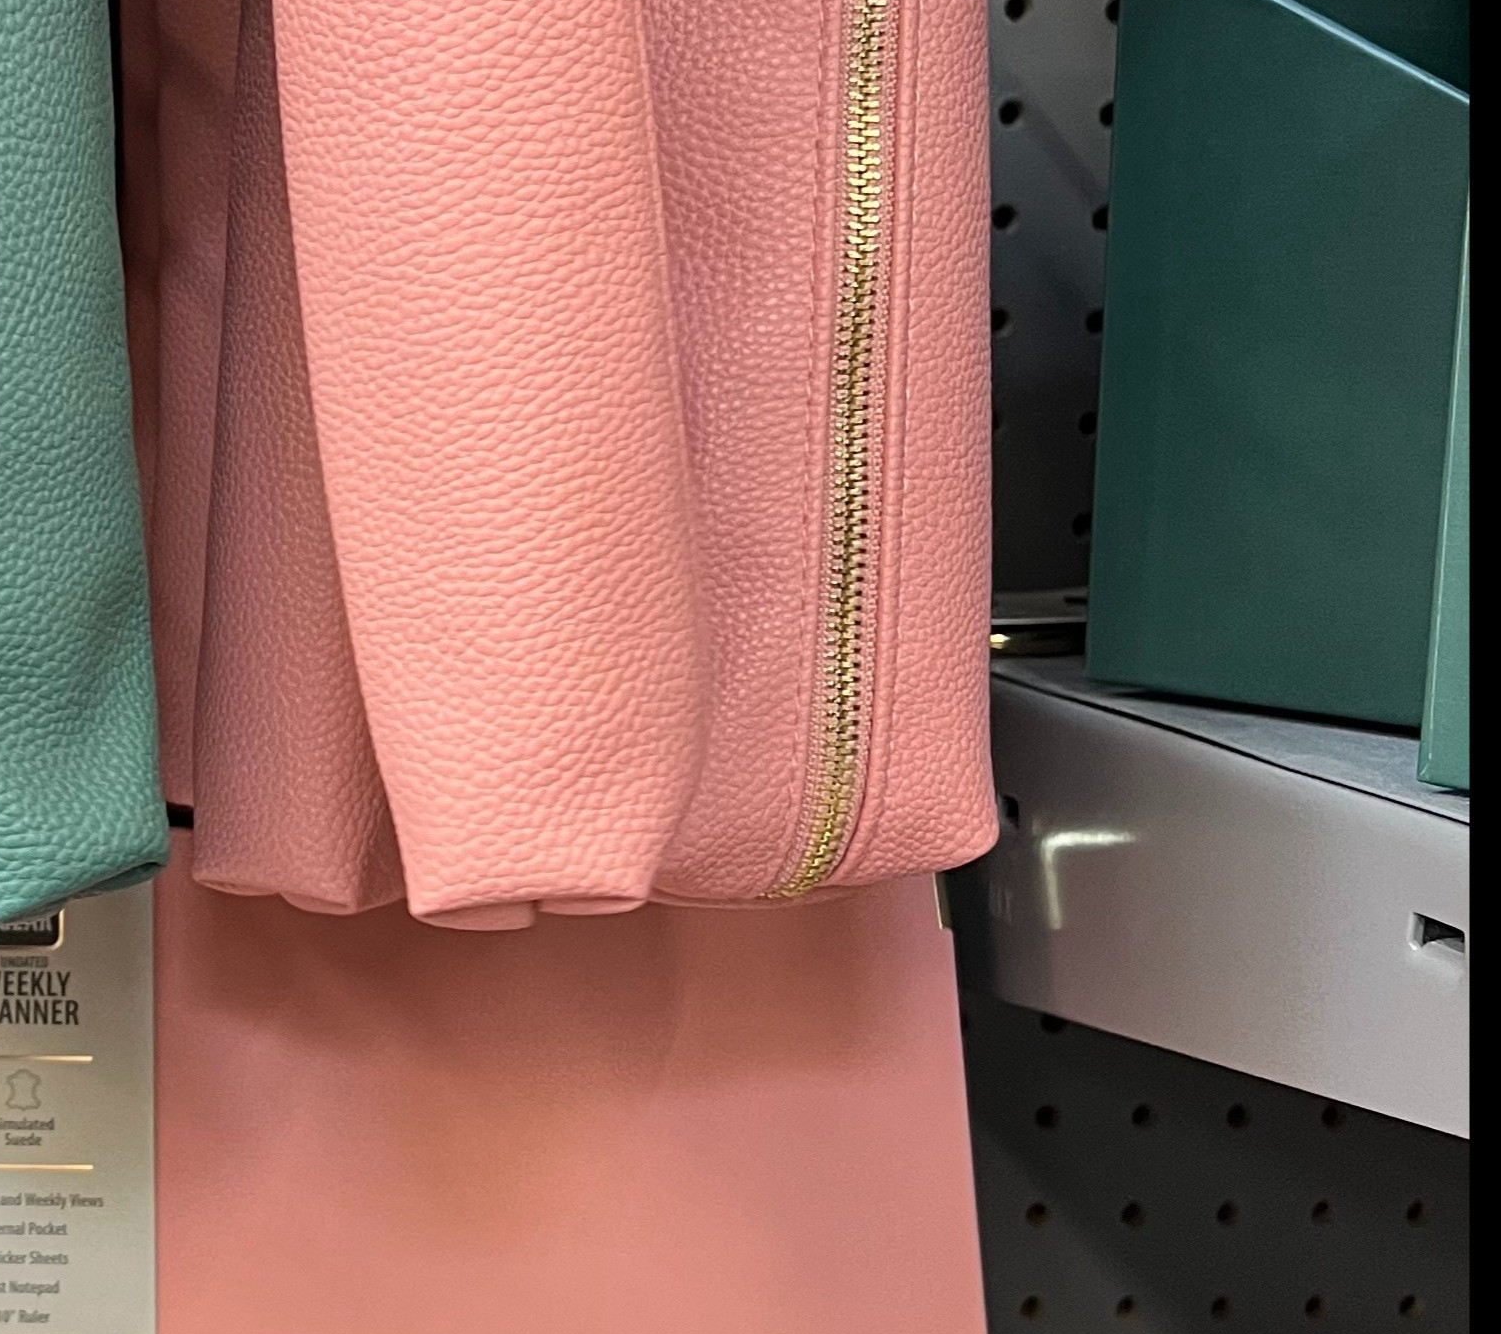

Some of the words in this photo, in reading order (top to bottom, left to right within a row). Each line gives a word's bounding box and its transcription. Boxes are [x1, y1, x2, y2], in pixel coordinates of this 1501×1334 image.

[4, 1133, 42, 1146] Suede
[0, 1193, 22, 1206] and
[25, 1193, 67, 1209] Weekly
[70, 1193, 104, 1207] Views
[28, 1222, 68, 1235] Pocket
[30, 1251, 69, 1265] Sheets
[9, 1280, 60, 1297] Notepad
[18, 1310, 50, 1323] Ruler
